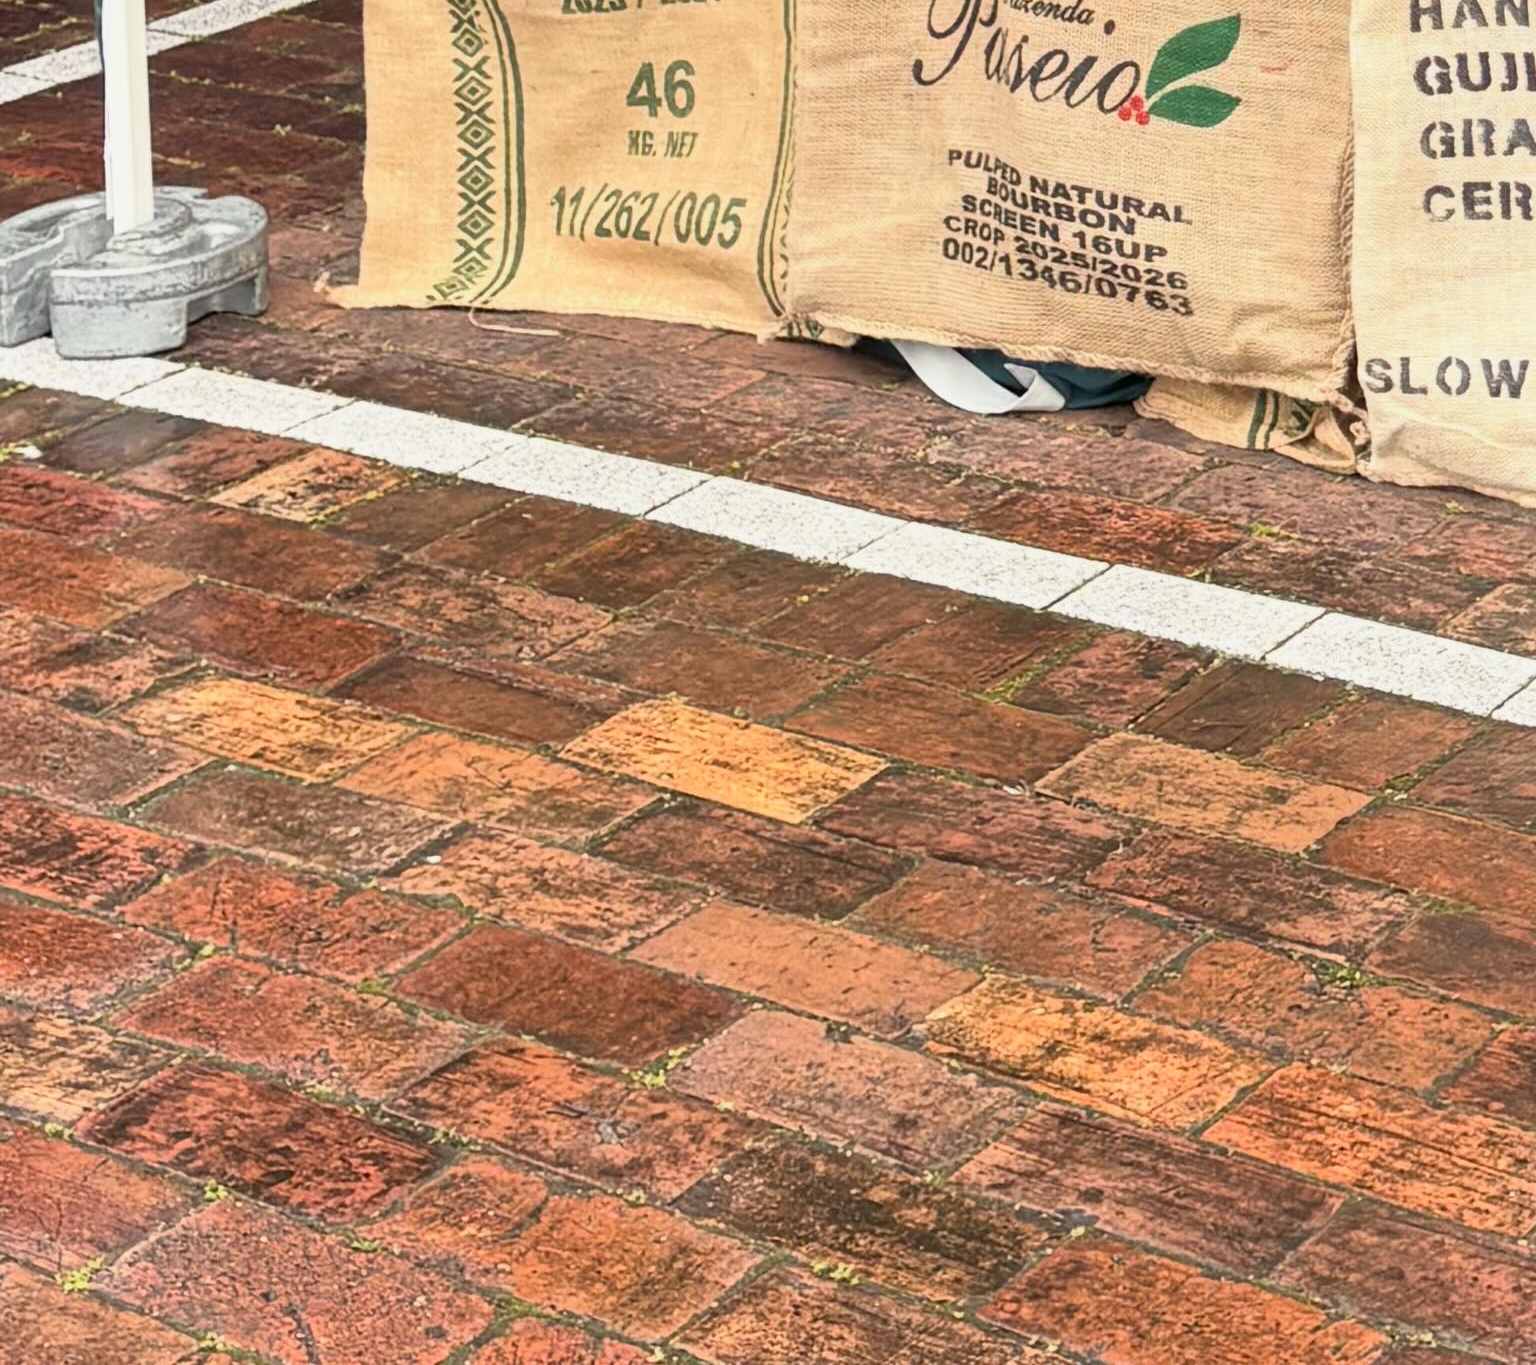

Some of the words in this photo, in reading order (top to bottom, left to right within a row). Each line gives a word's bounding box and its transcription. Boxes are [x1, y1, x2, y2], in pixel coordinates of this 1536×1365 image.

[626, 59, 695, 118] 46
[664, 131, 698, 157] NET
[550, 182, 747, 249] 11/262/005
[948, 149, 1021, 185] PULPED
[1029, 175, 1193, 225] NATURAL
[986, 176, 1136, 235] BOURBON
[943, 215, 1005, 246] CROP
[1014, 236, 1188, 290] 2025/2026
[961, 194, 1060, 242] SCREEN
[1072, 231, 1168, 262] 16UP
[942, 238, 1194, 317] 002/1346/0763
[1365, 356, 1529, 399] SLOW
